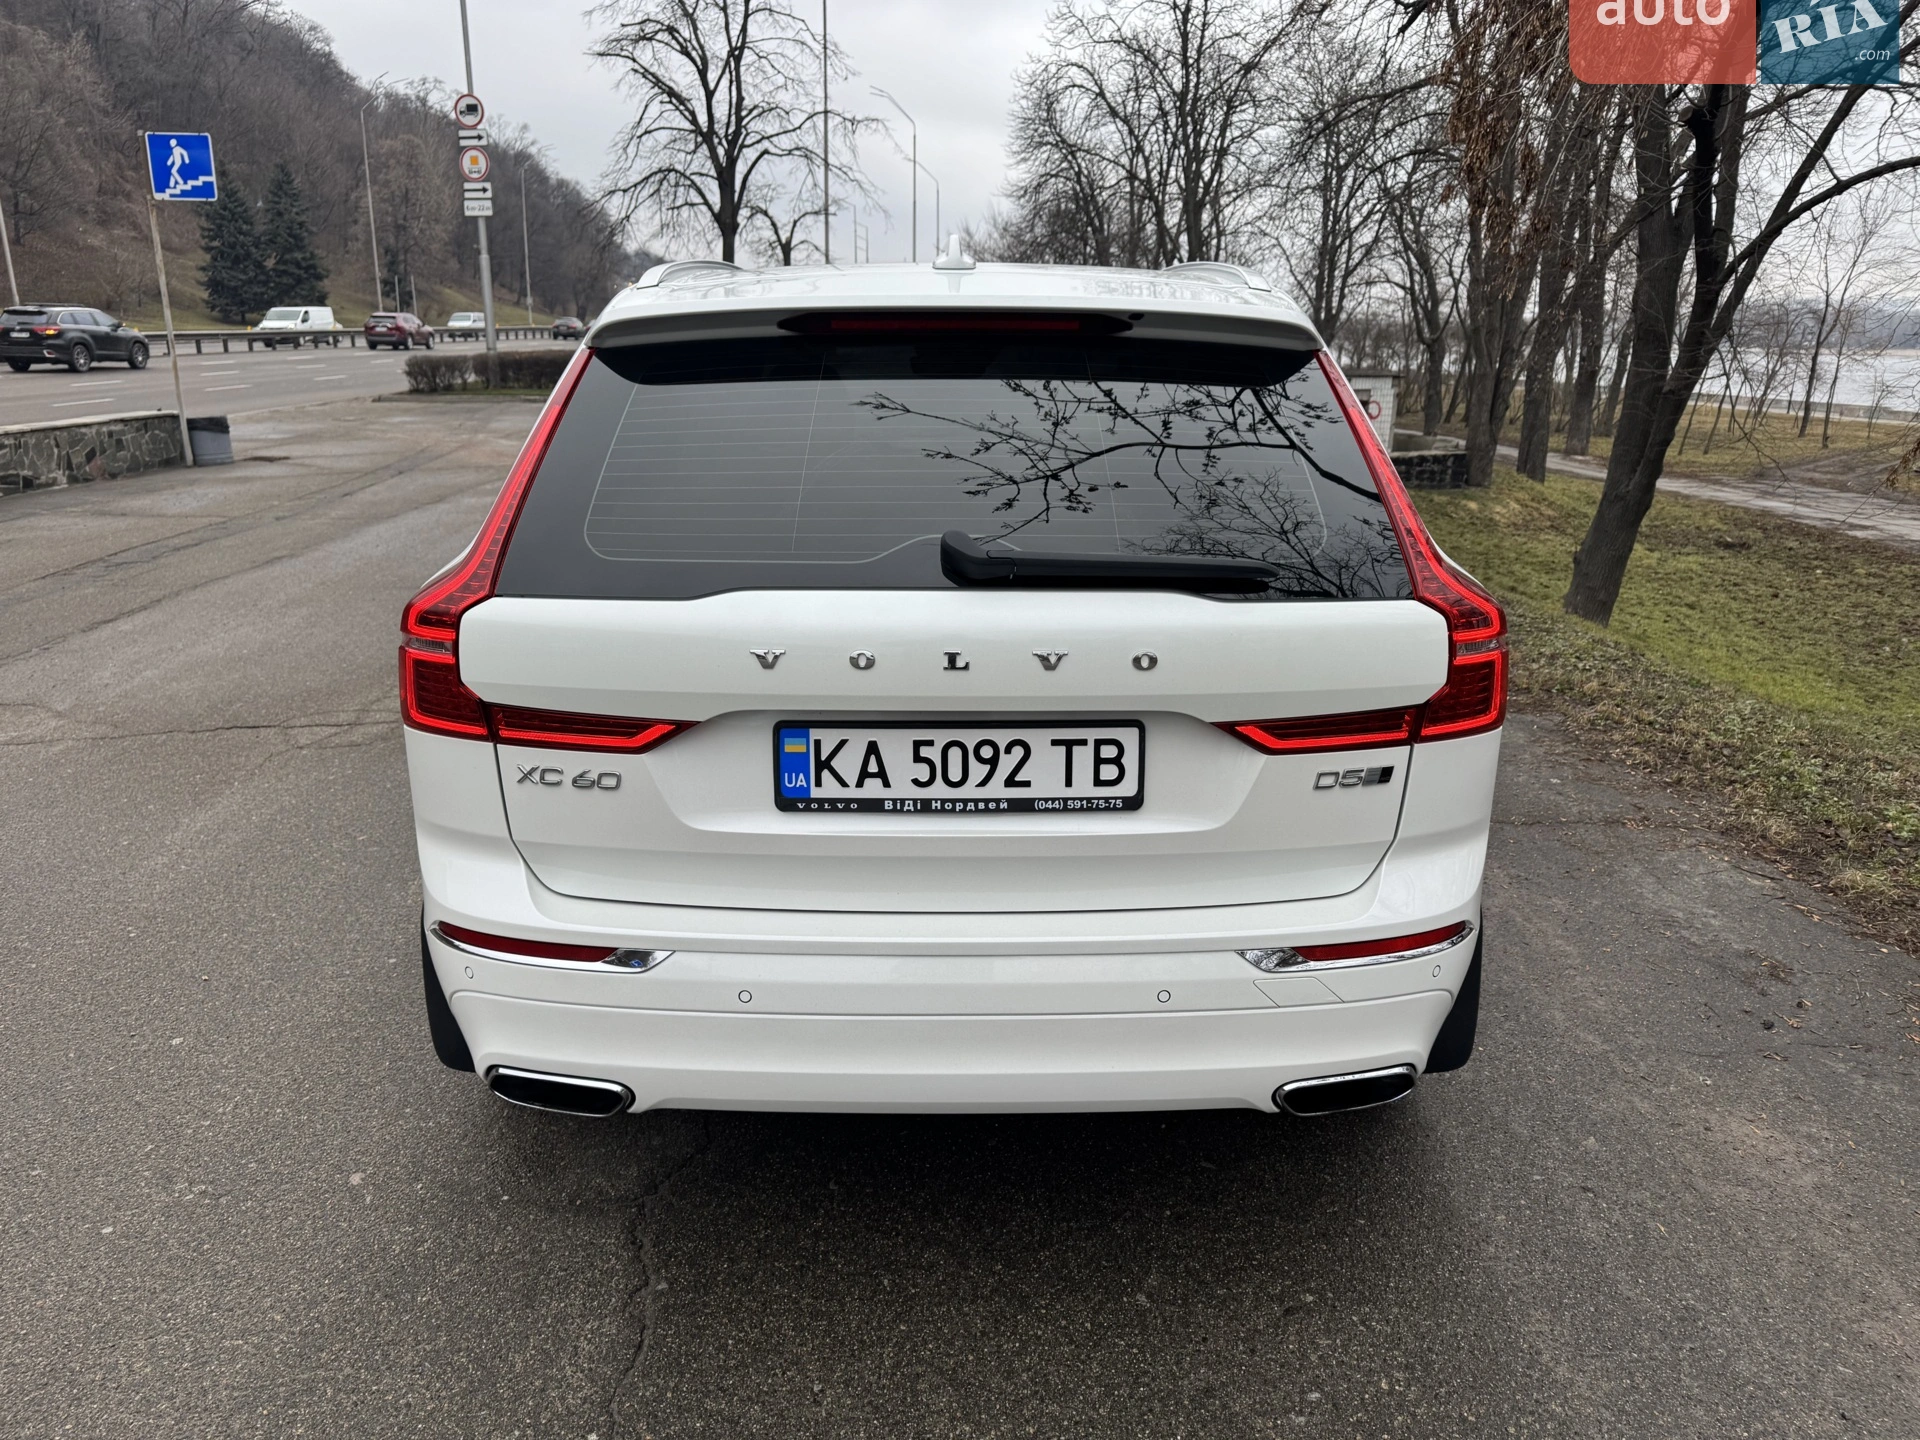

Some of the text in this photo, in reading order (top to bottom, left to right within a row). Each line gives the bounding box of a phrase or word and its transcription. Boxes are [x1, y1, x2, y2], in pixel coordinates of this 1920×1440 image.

[749, 648, 1158, 671] VOLVO
[813, 738, 1126, 788] KA 5092 TB
[516, 764, 622, 790] XC 60
[784, 772, 808, 788] UA
[1313, 767, 1365, 790] D5
[796, 802, 858, 810] VOLVO
[931, 799, 1009, 812] Нордвей
[1033, 799, 1123, 811] (044) 591-75-75
